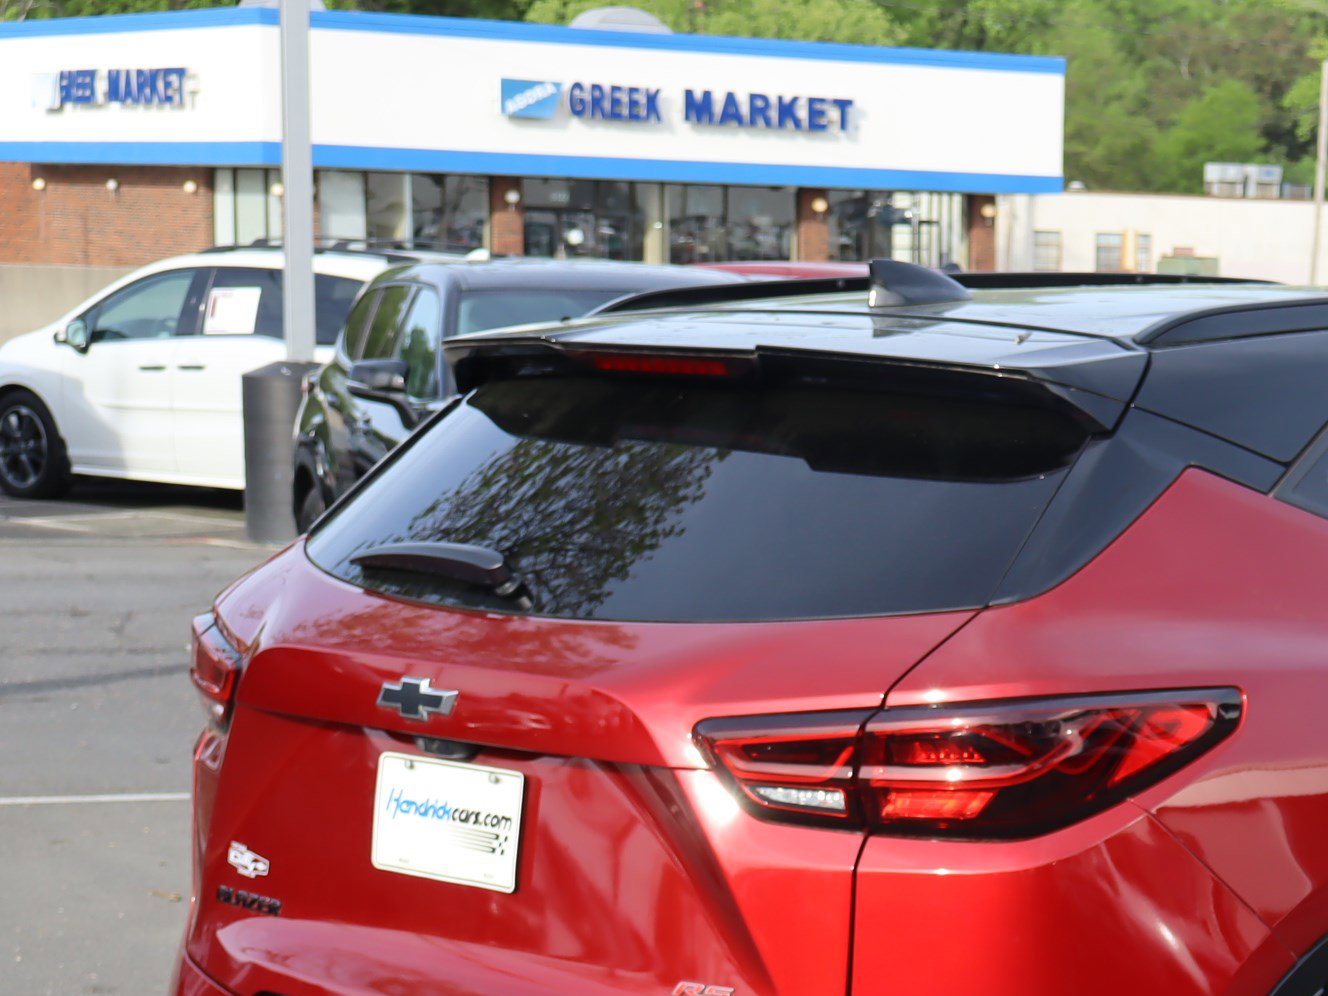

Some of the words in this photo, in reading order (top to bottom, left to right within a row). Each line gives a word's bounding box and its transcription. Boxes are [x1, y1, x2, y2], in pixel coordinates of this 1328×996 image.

[106, 67, 187, 104] MARKET
[568, 81, 662, 123] GREEK
[684, 88, 854, 132] MARKET
[386, 787, 512, 832] Hendrickcars.com
